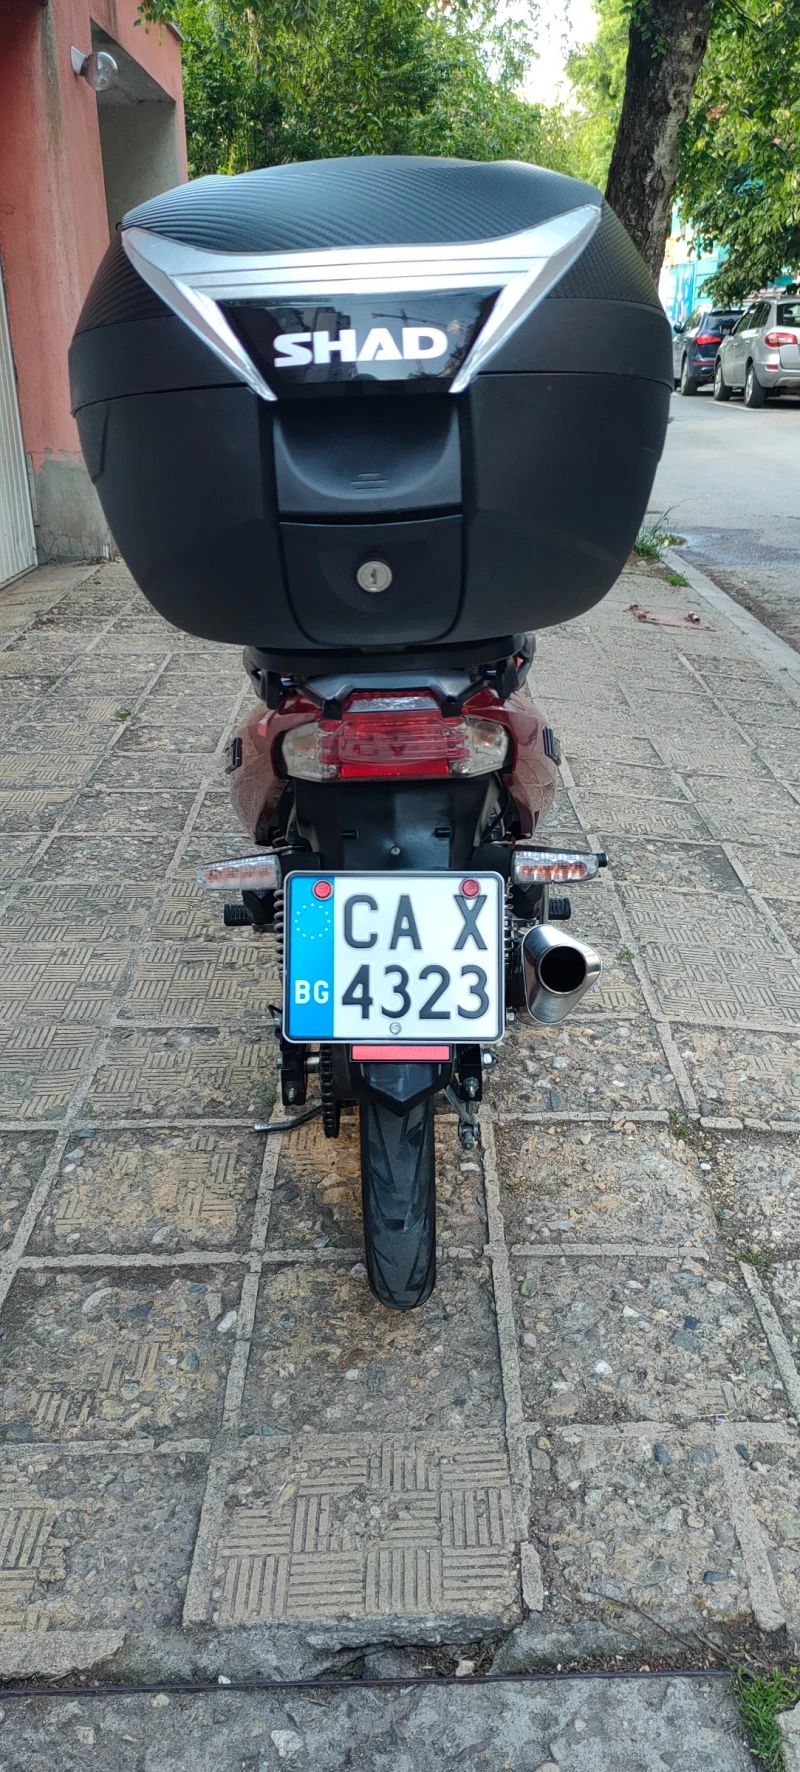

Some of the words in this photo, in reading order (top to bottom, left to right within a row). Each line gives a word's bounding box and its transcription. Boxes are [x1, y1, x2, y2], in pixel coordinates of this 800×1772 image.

[273, 327, 448, 367] SHAD
[343, 894, 422, 950] CA
[453, 894, 488, 950] X
[294, 980, 329, 1004] BG
[341, 964, 490, 1020] 4323
